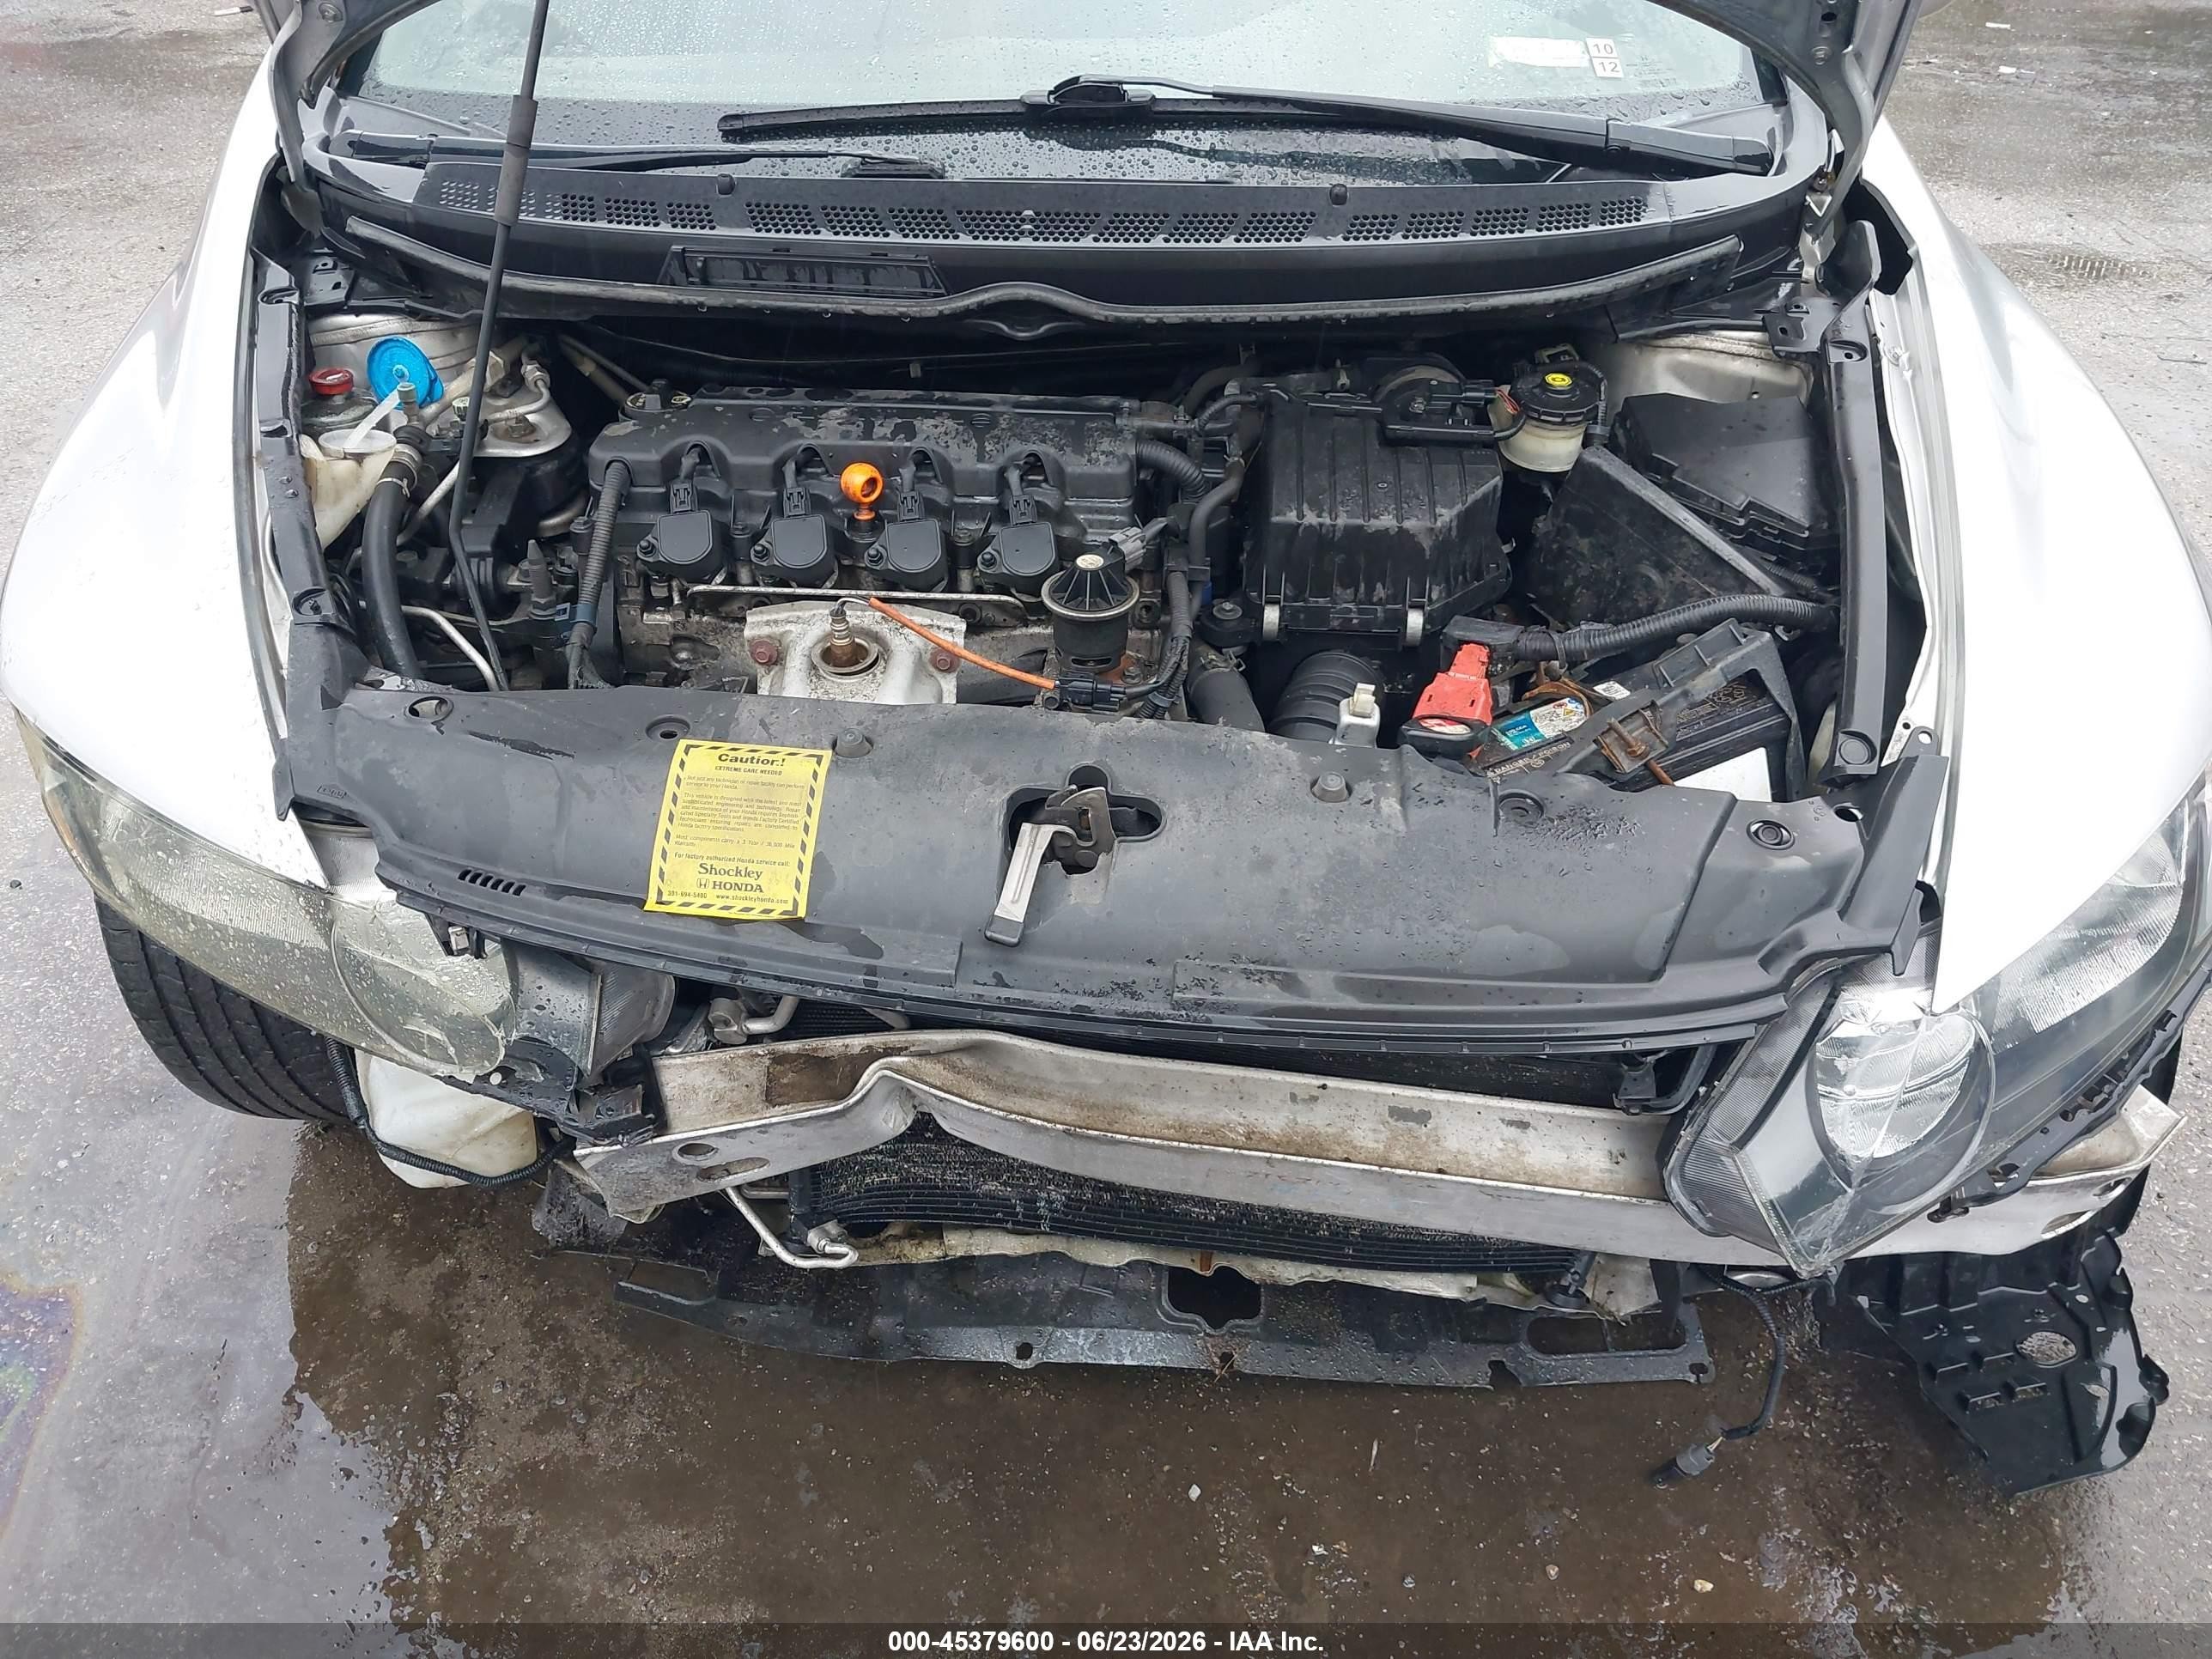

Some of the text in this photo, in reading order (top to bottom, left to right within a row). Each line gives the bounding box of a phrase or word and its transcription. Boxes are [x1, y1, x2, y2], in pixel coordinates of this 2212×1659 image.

[1593, 44, 1613, 55] 10
[1599, 61, 1620, 73] 12
[696, 862, 764, 880] Shockley
[711, 880, 765, 892] HONDA
